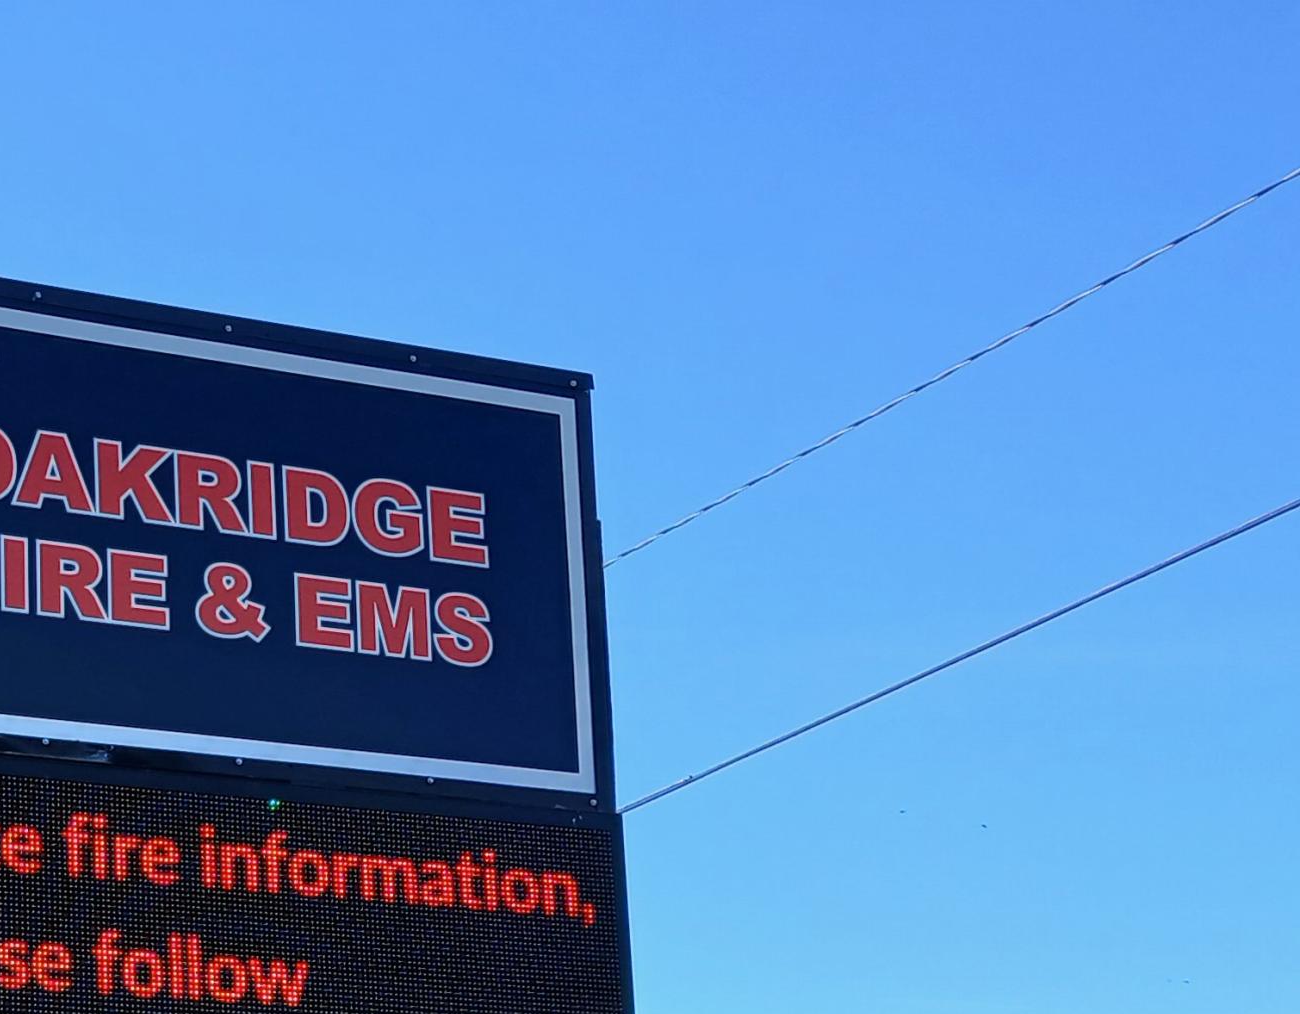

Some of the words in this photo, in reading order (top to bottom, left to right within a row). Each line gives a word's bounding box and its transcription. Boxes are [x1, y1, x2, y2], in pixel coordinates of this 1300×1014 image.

[195, 561, 271, 643] &
[293, 572, 493, 668] EMS
[63, 811, 181, 886] fire
[199, 822, 597, 928] information,
[93, 928, 310, 1008] follow
